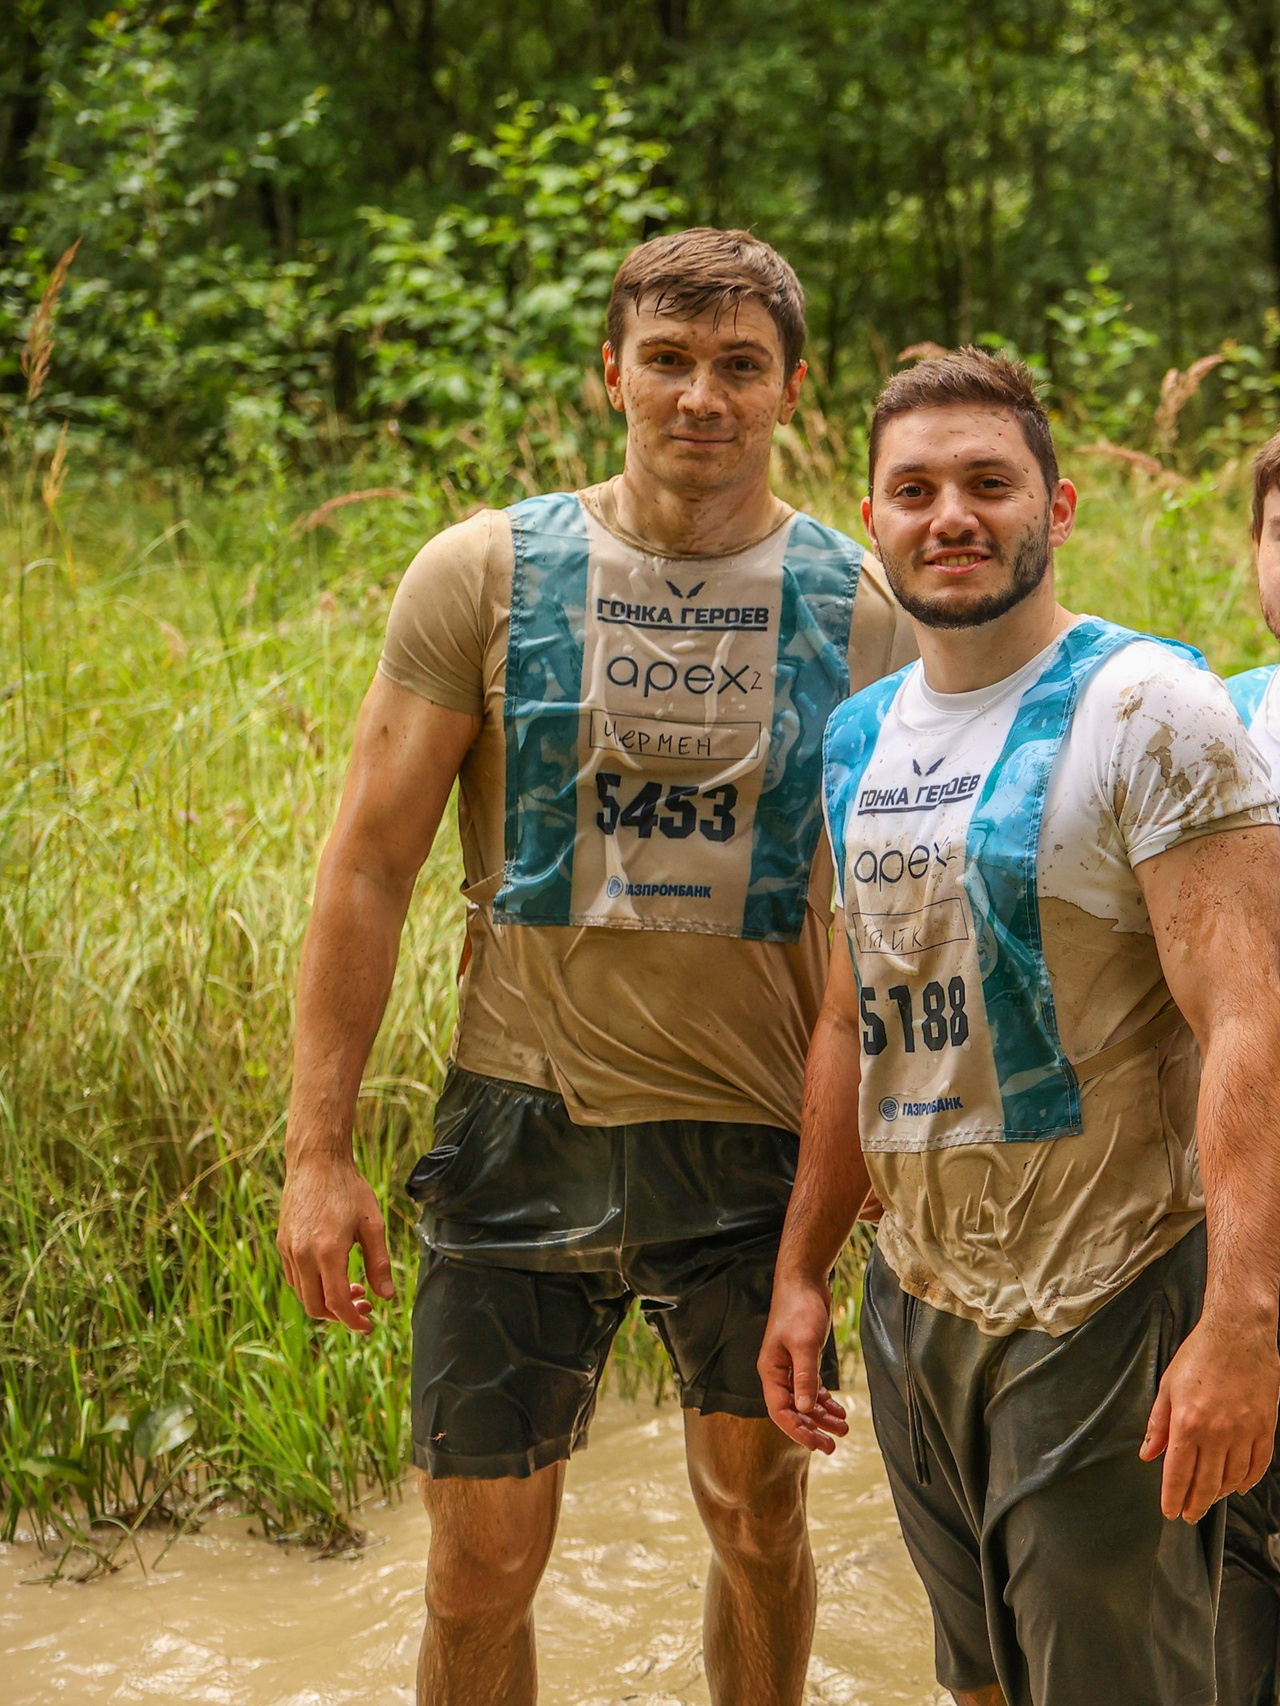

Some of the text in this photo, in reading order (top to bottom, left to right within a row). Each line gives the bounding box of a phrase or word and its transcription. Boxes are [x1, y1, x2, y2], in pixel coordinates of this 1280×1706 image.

[597, 598, 769, 625] ГОНКА ГЕРОЕВ
[595, 772, 739, 842] 5453
[858, 774, 981, 809] ГОНКА ГЕРОЕВ
[625, 883, 712, 899] АЗПРОМБАНК
[861, 975, 970, 1056] 5188
